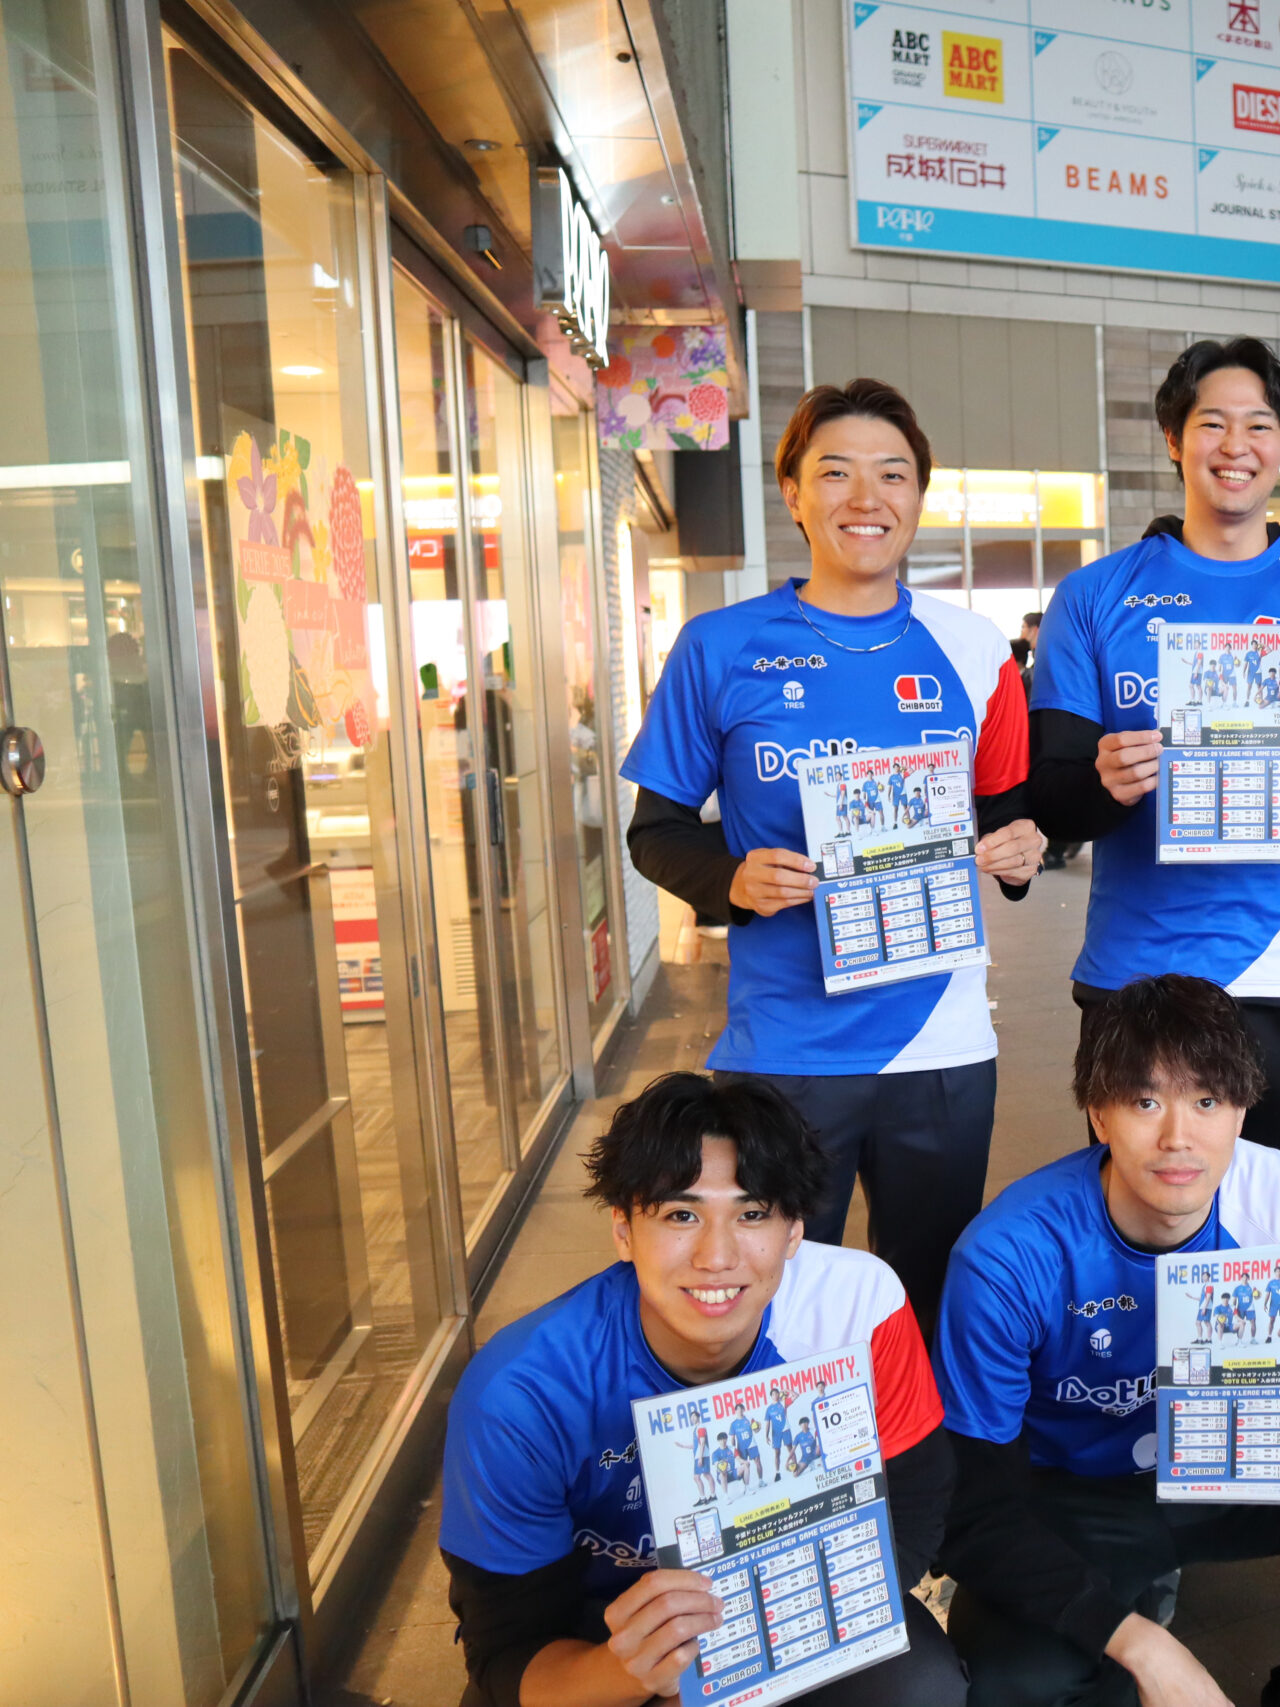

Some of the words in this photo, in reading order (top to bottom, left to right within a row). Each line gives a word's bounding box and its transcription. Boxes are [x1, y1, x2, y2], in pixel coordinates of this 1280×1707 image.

[892, 29, 930, 51] ABC
[892, 50, 930, 66] MART
[949, 44, 997, 73] ABC
[949, 70, 998, 92] MART
[903, 134, 988, 156] SUPERMARKET
[886, 153, 1006, 190] 成城石井
[1065, 164, 1168, 199] BEAMS
[1211, 202, 1265, 218] JOURNAL
[1124, 593, 1192, 607] 千葉日報
[1167, 632, 1183, 650] WE
[1186, 632, 1208, 650] ARE
[1210, 633, 1248, 650] DREAM
[753, 654, 827, 672] 千葉日報
[783, 701, 805, 709] TRES
[807, 767, 824, 786] WE
[826, 763, 850, 782] ARE
[852, 757, 890, 780] DREAM
[931, 785, 946, 797] 10
[1167, 1264, 1188, 1285] WE
[1191, 1263, 1220, 1285] ARE
[1223, 1259, 1271, 1284] DREAM
[648, 1407, 675, 1436] WE
[676, 1398, 711, 1429] ARE
[712, 1381, 768, 1420] DREAM
[822, 1412, 842, 1429] 10
[814, 1468, 836, 1482] VOLLEY
[781, 1537, 797, 1549] MEN
[798, 1528, 818, 1541] GAME
[819, 1513, 858, 1534] SCHEDULE!
